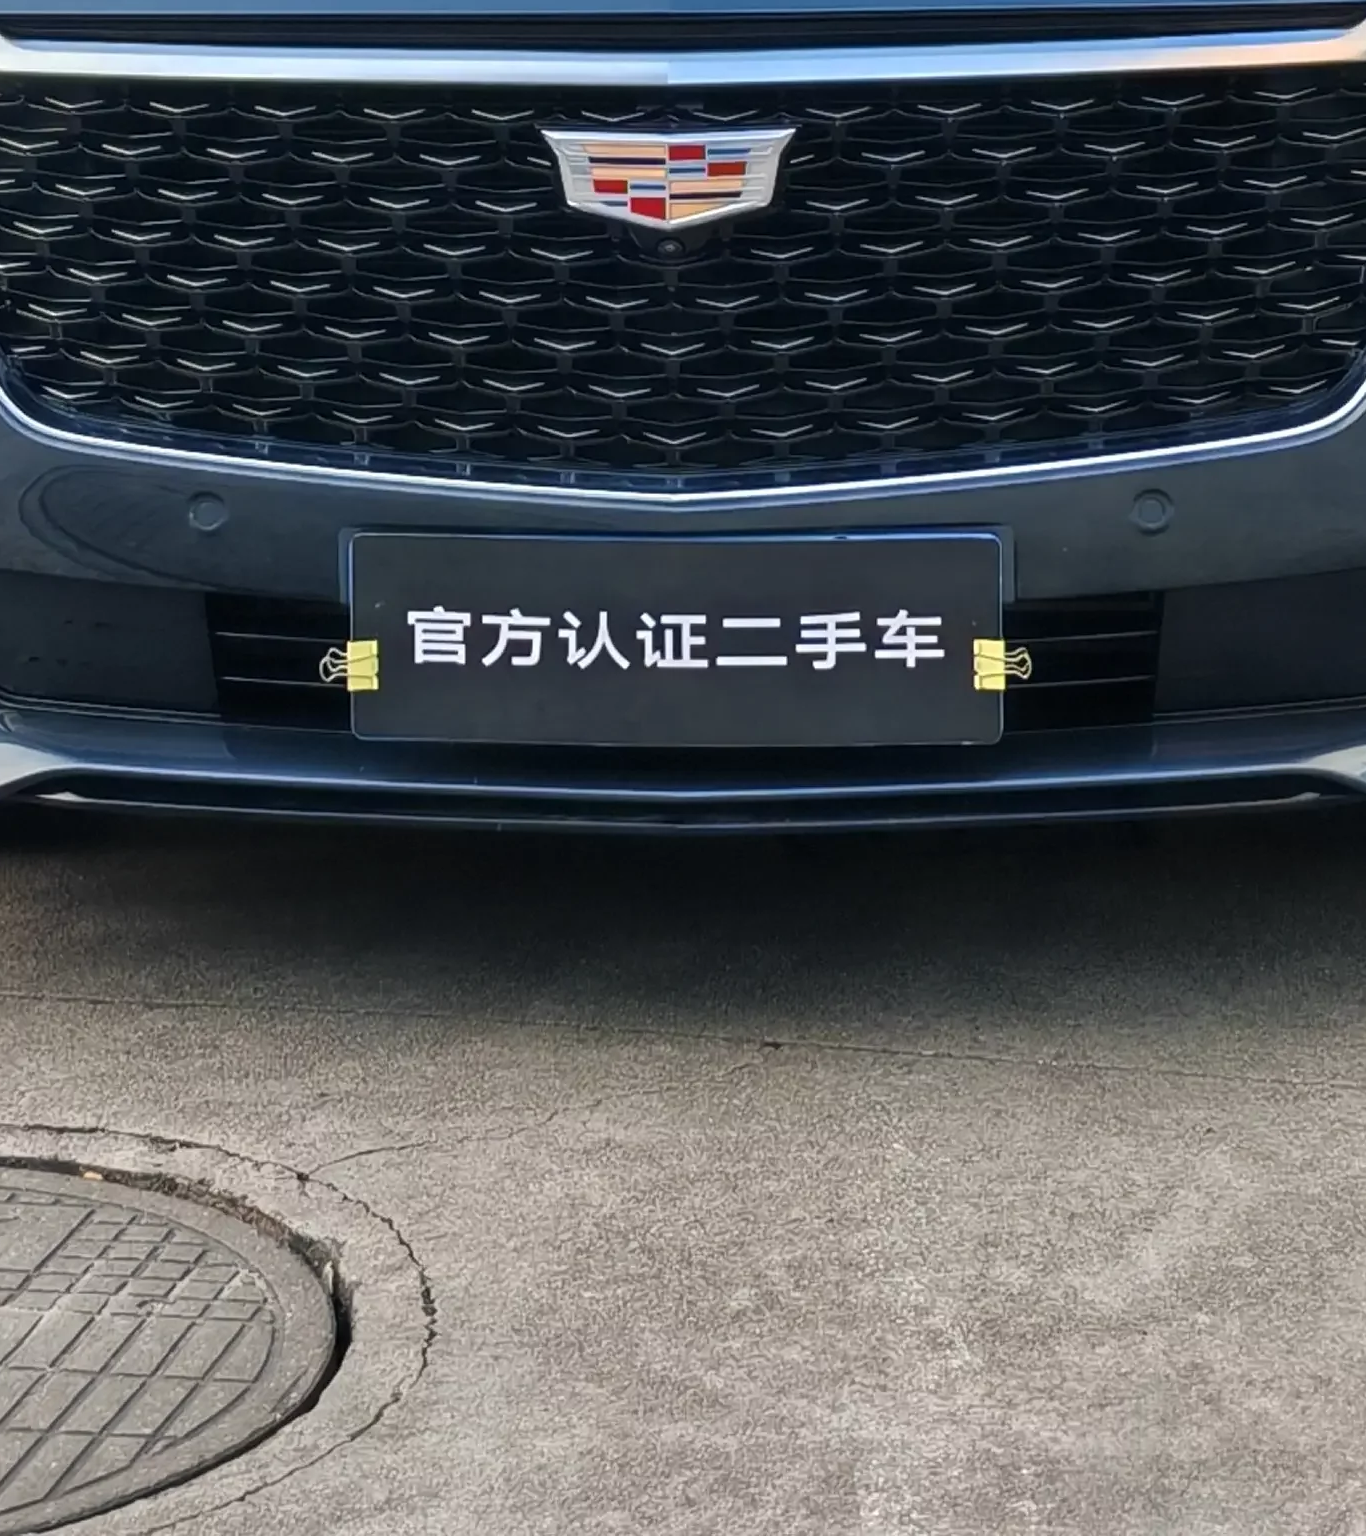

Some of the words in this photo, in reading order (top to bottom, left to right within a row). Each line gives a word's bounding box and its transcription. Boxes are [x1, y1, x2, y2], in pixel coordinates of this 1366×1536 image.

[407, 607, 947, 672] 官方认证二手车
